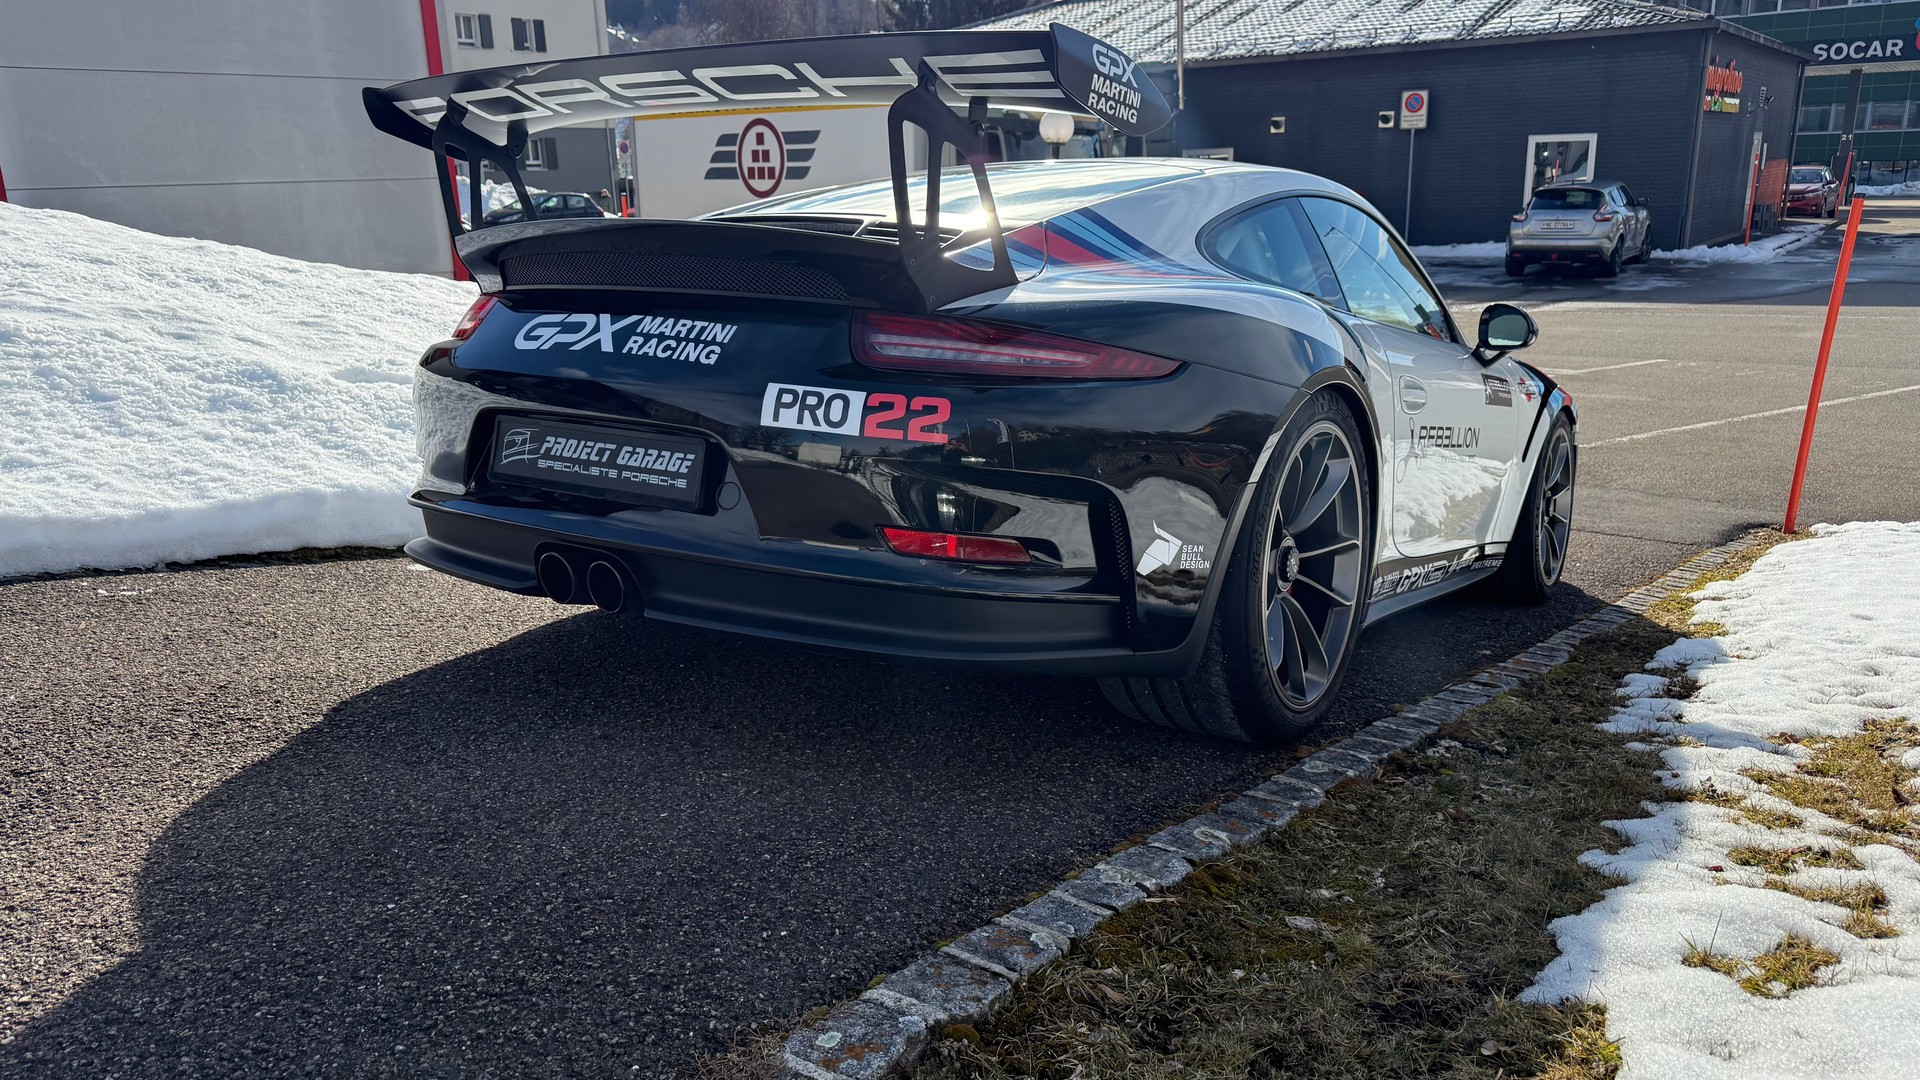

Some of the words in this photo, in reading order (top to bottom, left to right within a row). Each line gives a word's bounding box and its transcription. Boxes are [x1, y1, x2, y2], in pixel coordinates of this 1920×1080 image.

[1813, 39, 1904, 61] SOCAR
[1092, 43, 1138, 88] GPX
[392, 48, 1067, 131] PORSCHE
[1091, 73, 1141, 108] MARTINI
[1088, 92, 1138, 124] RACING
[514, 313, 645, 353] GPX
[636, 315, 738, 344] MARTINI
[621, 335, 721, 366] RACING
[1418, 425, 1480, 449] REBELLION
[539, 436, 617, 463] PROJECT
[616, 445, 696, 474] GARAGE
[537, 459, 618, 479] SPECIALISTE
[621, 471, 688, 489] PORSCHE
[1181, 553, 1202, 561] BULL
[1182, 545, 1205, 553] SEAN
[1180, 560, 1210, 569] DESIGN
